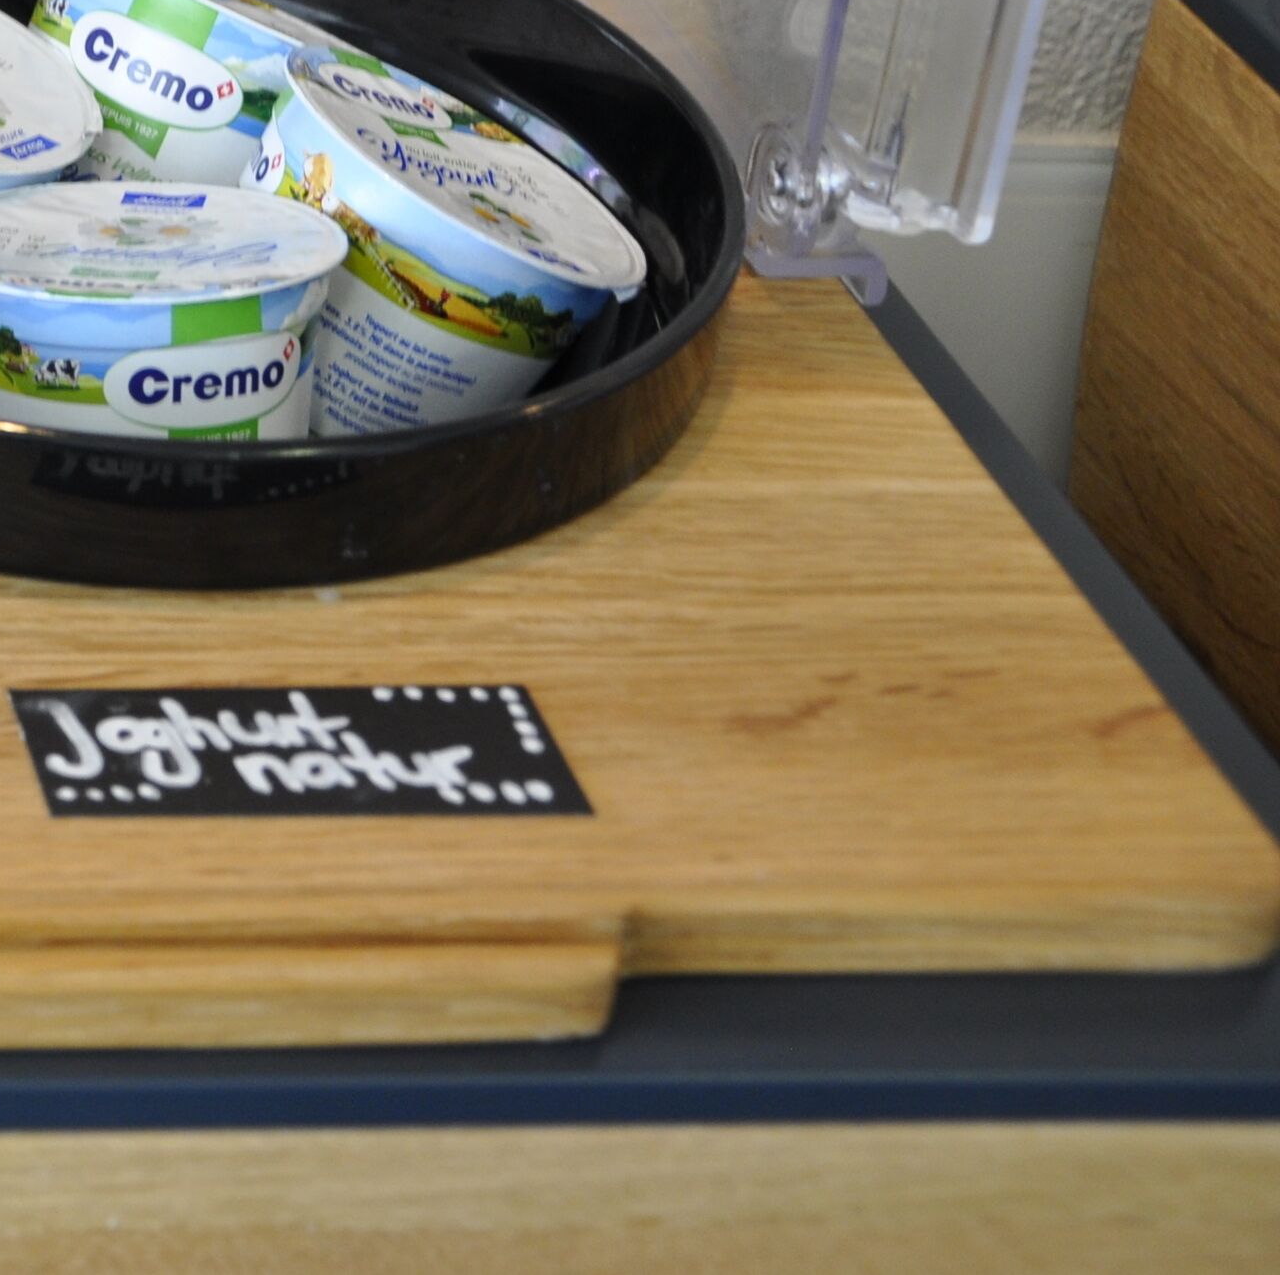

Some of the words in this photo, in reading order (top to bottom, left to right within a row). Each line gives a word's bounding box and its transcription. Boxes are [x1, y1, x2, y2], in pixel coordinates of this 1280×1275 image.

[83, 26, 214, 113] Cremo
[333, 72, 435, 120] Cremo
[357, 128, 513, 197] Yogourt
[128, 359, 286, 406] Cremo
[25, 691, 350, 787] Joghurt
